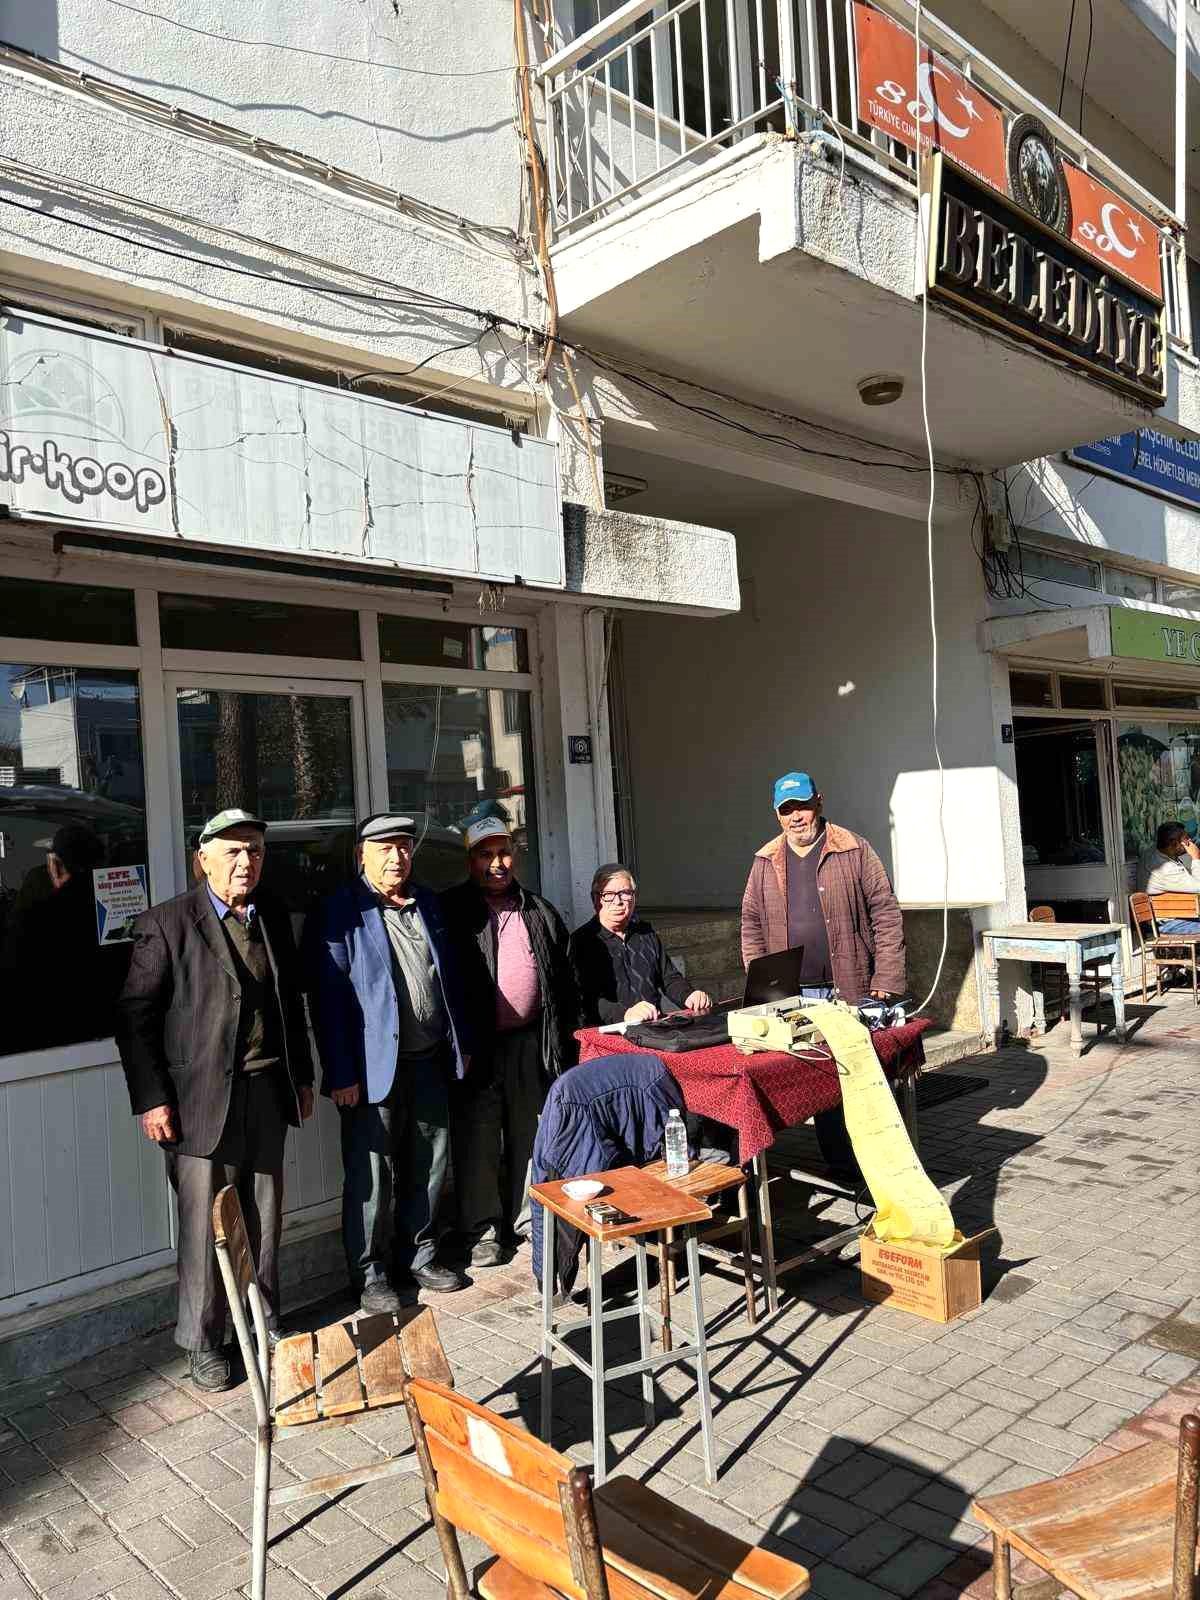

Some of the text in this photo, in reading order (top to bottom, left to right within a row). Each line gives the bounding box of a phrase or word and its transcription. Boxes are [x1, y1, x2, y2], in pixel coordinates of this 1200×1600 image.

[876, 80, 932, 122] 80
[1078, 221, 1113, 252] 80
[939, 192, 1162, 384] BELEDİYE
[878, 1248, 922, 1269] EGEFORM
